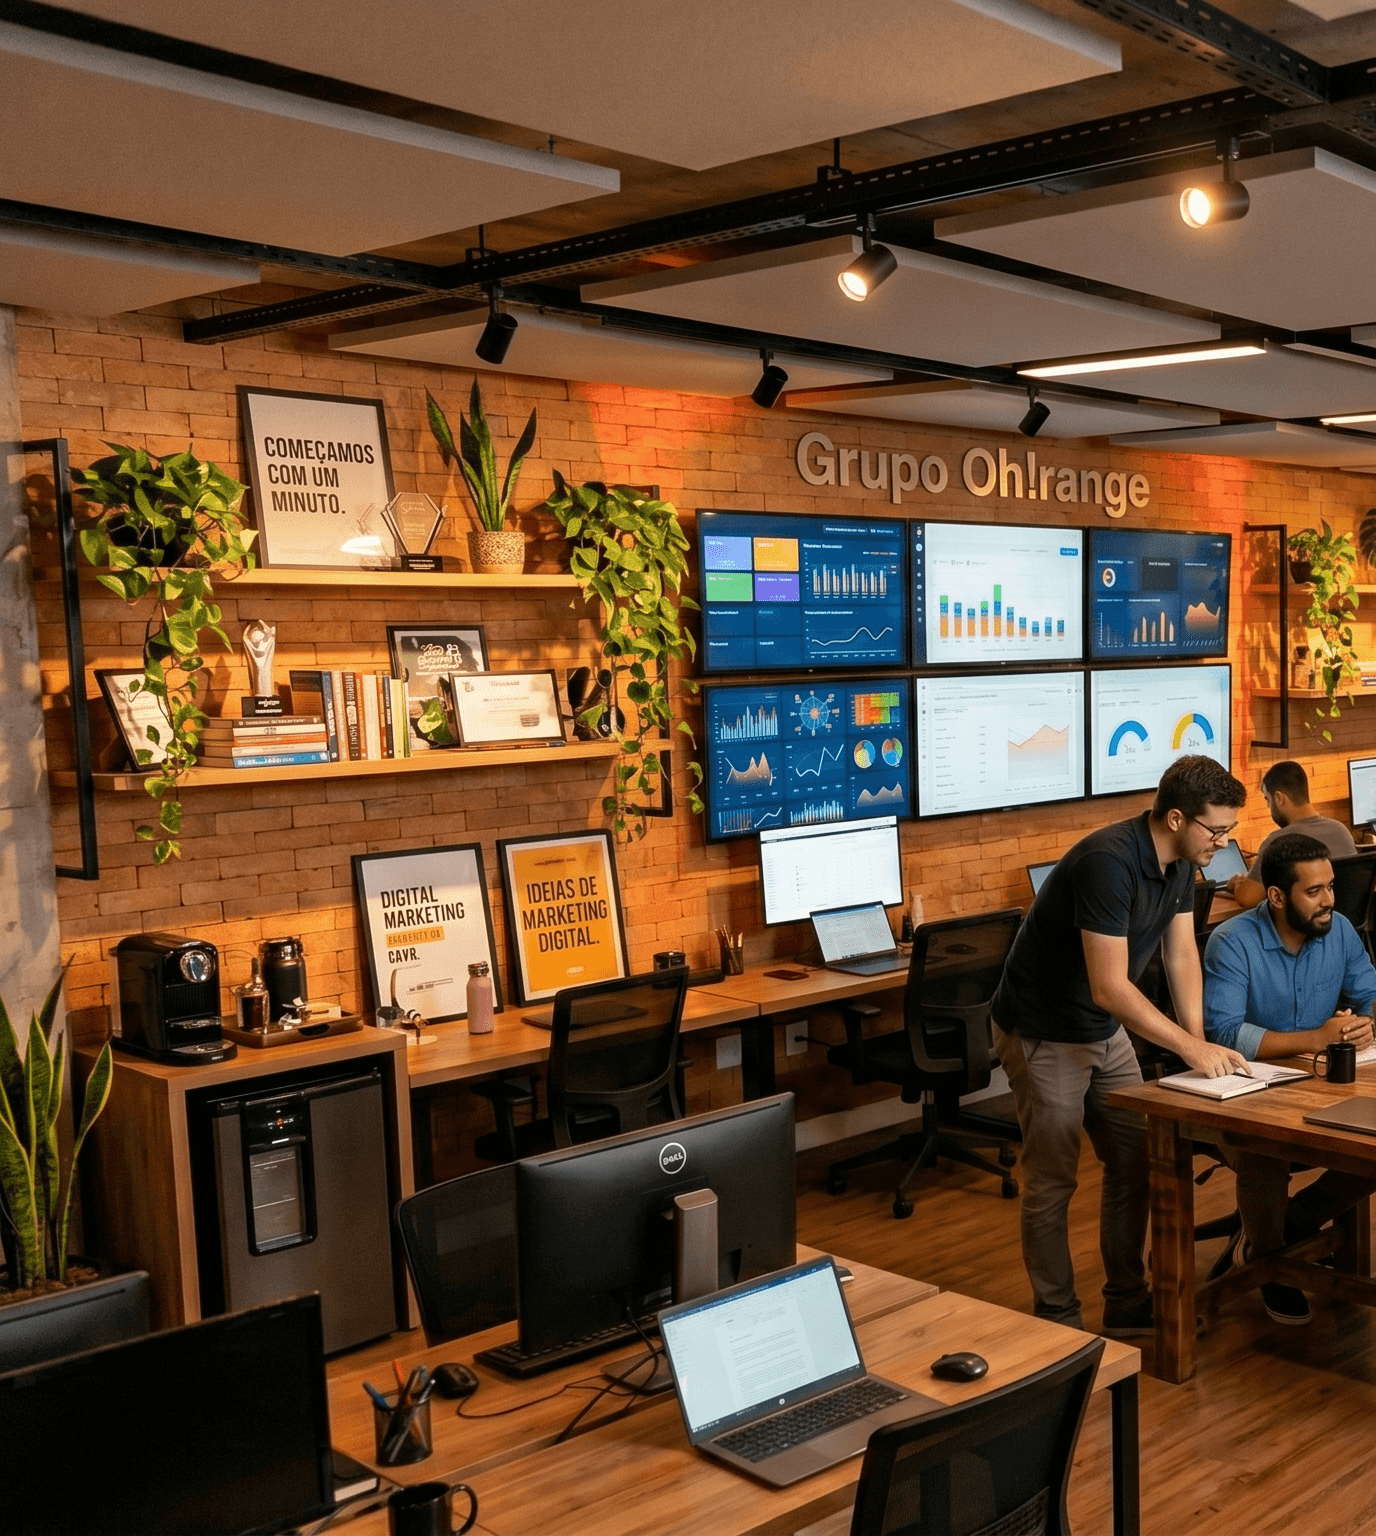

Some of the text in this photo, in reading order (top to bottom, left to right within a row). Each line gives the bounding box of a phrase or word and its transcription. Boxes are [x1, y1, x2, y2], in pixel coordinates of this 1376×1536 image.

[264, 436, 375, 464] COMEÇAMOS
[268, 463, 340, 488] COM UM
[797, 432, 949, 504] Grupo
[271, 490, 346, 514] MINUTO.
[380, 885, 439, 909] DIGITAL
[526, 876, 598, 904] IDEIAS DE
[383, 902, 465, 929] MARKETING
[522, 899, 608, 931] MARKETING
[538, 926, 601, 953] DIGITAL.
[388, 947, 421, 964] CAVR.
